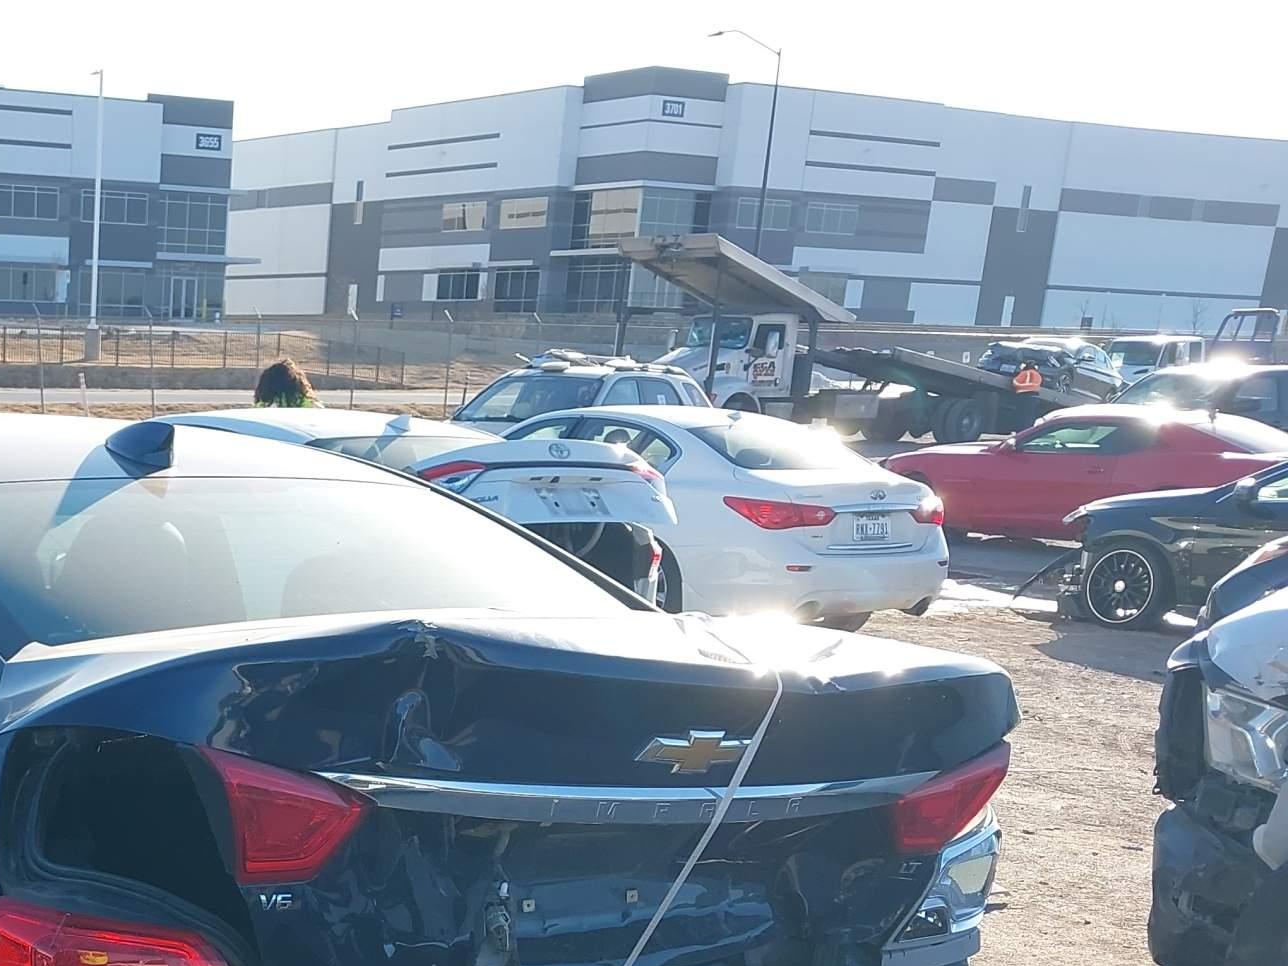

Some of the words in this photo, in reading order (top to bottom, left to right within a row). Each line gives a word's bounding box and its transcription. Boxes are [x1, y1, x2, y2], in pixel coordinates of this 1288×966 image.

[665, 102, 682, 115] 3701
[550, 798, 803, 819] IMPALA
[259, 894, 292, 911] V6
